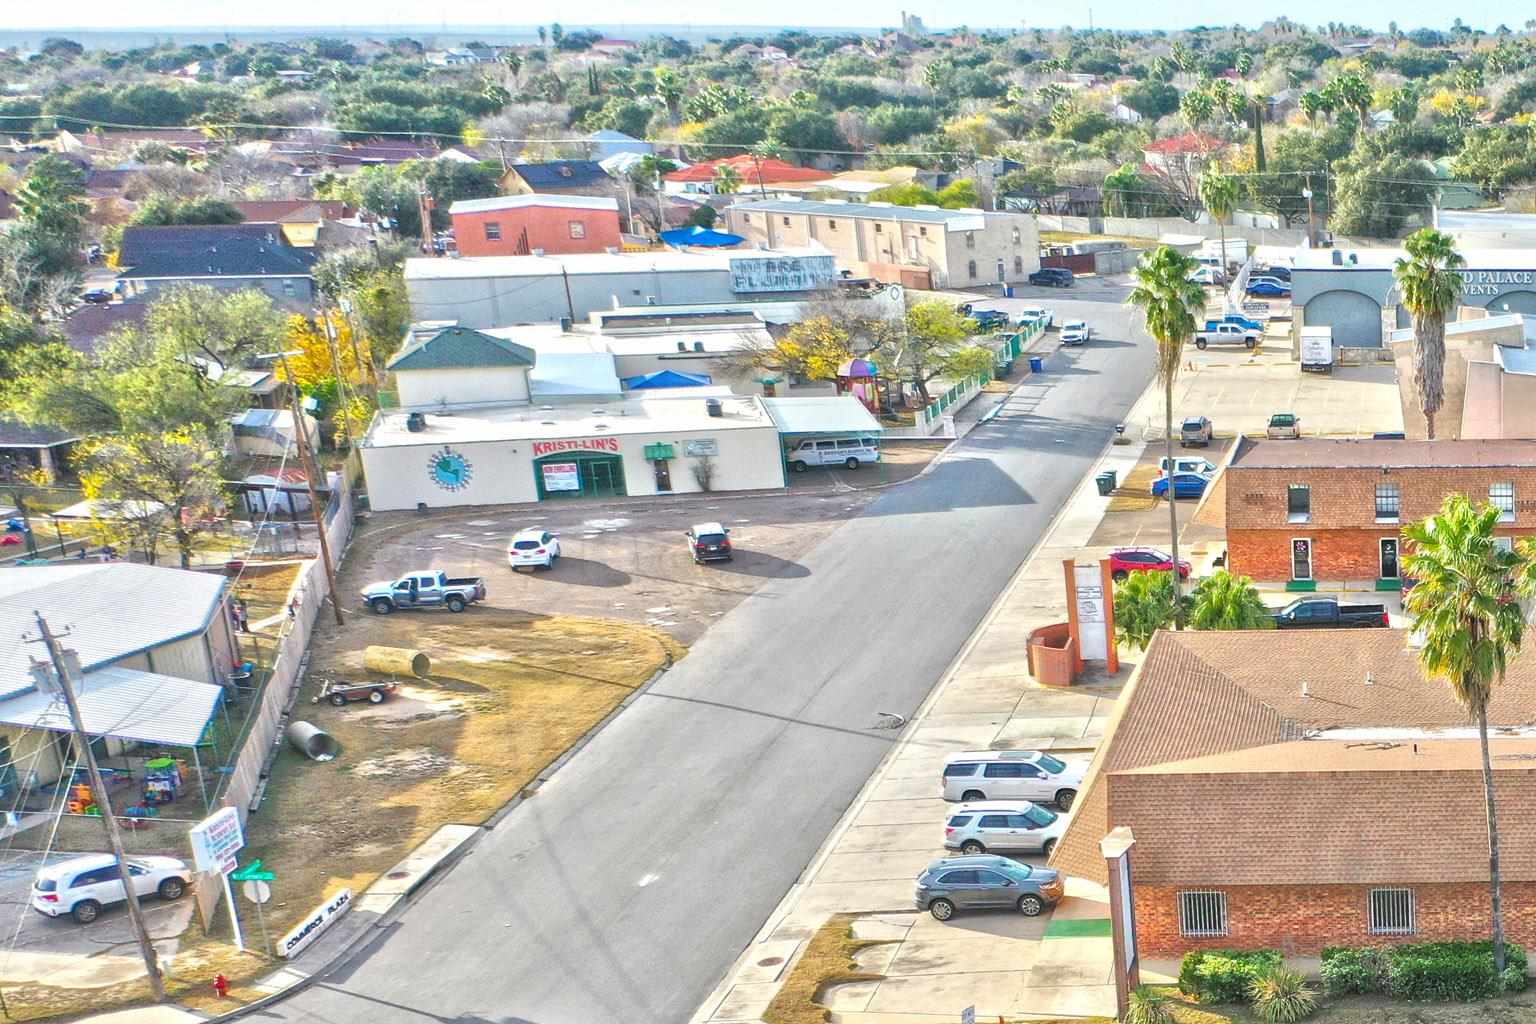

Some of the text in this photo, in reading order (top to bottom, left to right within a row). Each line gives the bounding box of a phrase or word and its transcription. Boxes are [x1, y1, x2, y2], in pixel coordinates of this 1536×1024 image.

[1479, 272, 1533, 284] PALACE
[1460, 285, 1499, 295] VENTS
[532, 437, 619, 456] KRISTI-LIN'S
